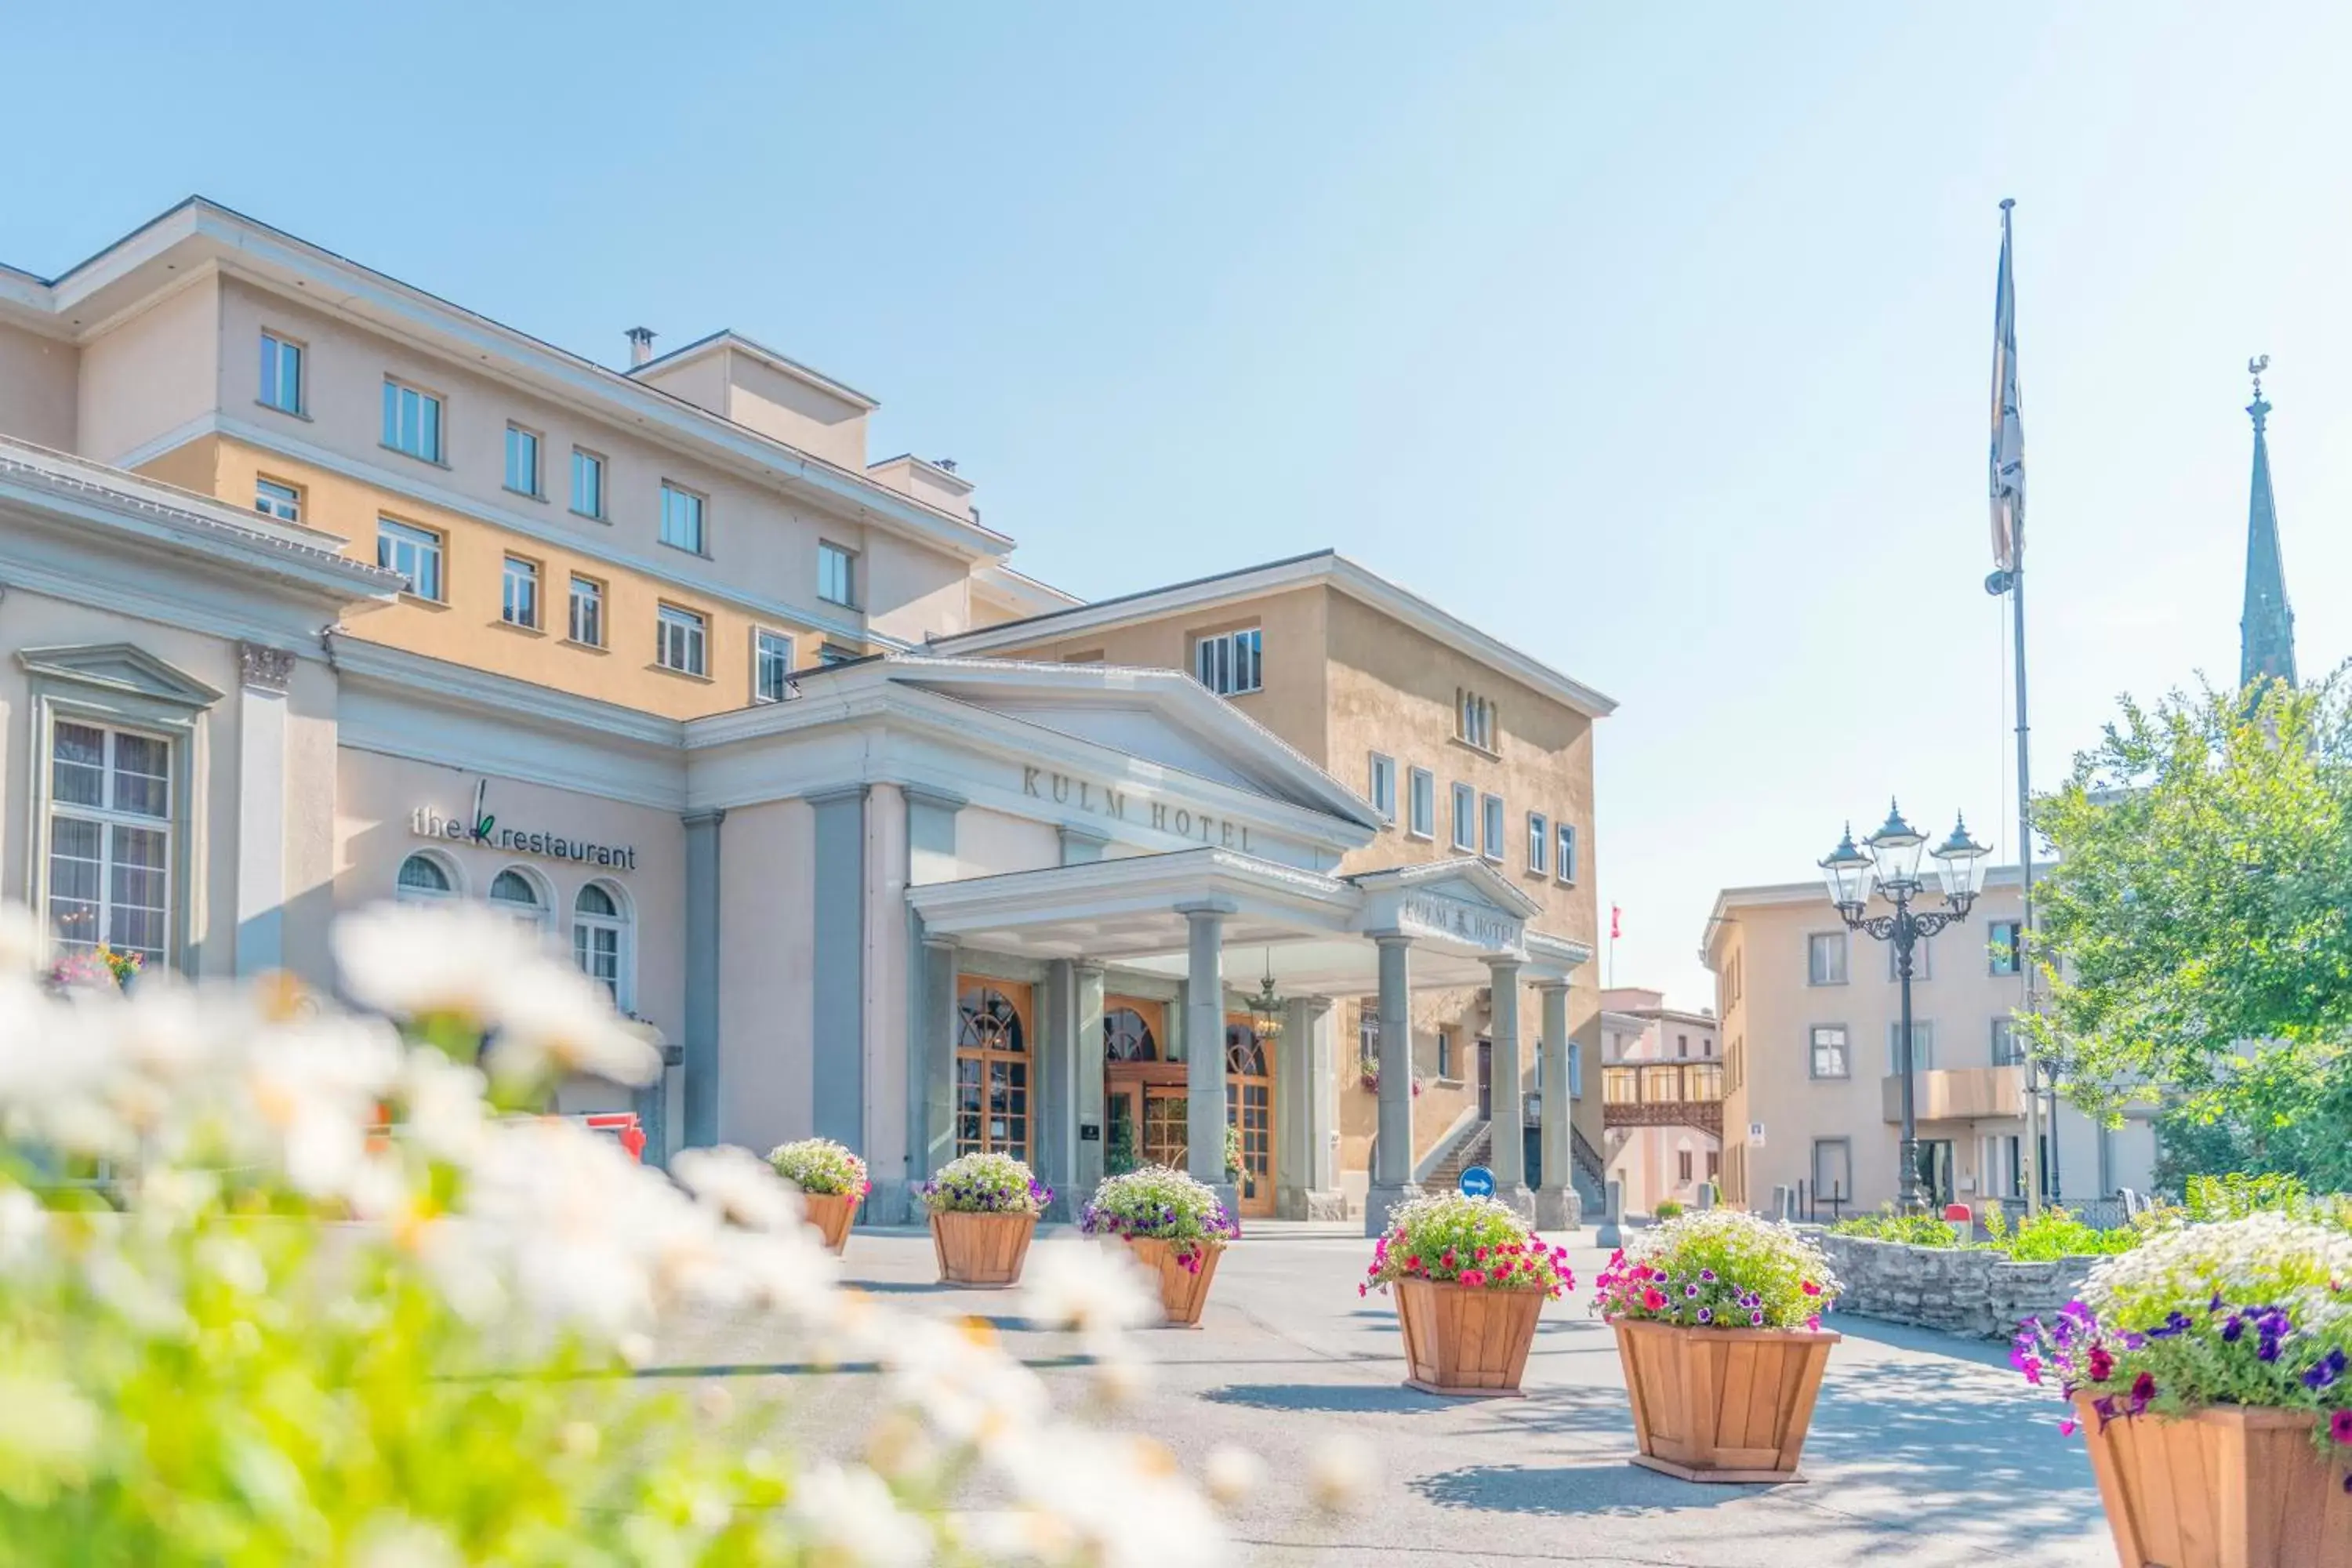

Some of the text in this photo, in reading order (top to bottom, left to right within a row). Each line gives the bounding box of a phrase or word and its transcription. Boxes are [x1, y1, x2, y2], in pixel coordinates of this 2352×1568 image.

[411, 805, 461, 839] the
[502, 827, 637, 870] restaurant
[1022, 764, 1255, 853] KULM HOTEL
